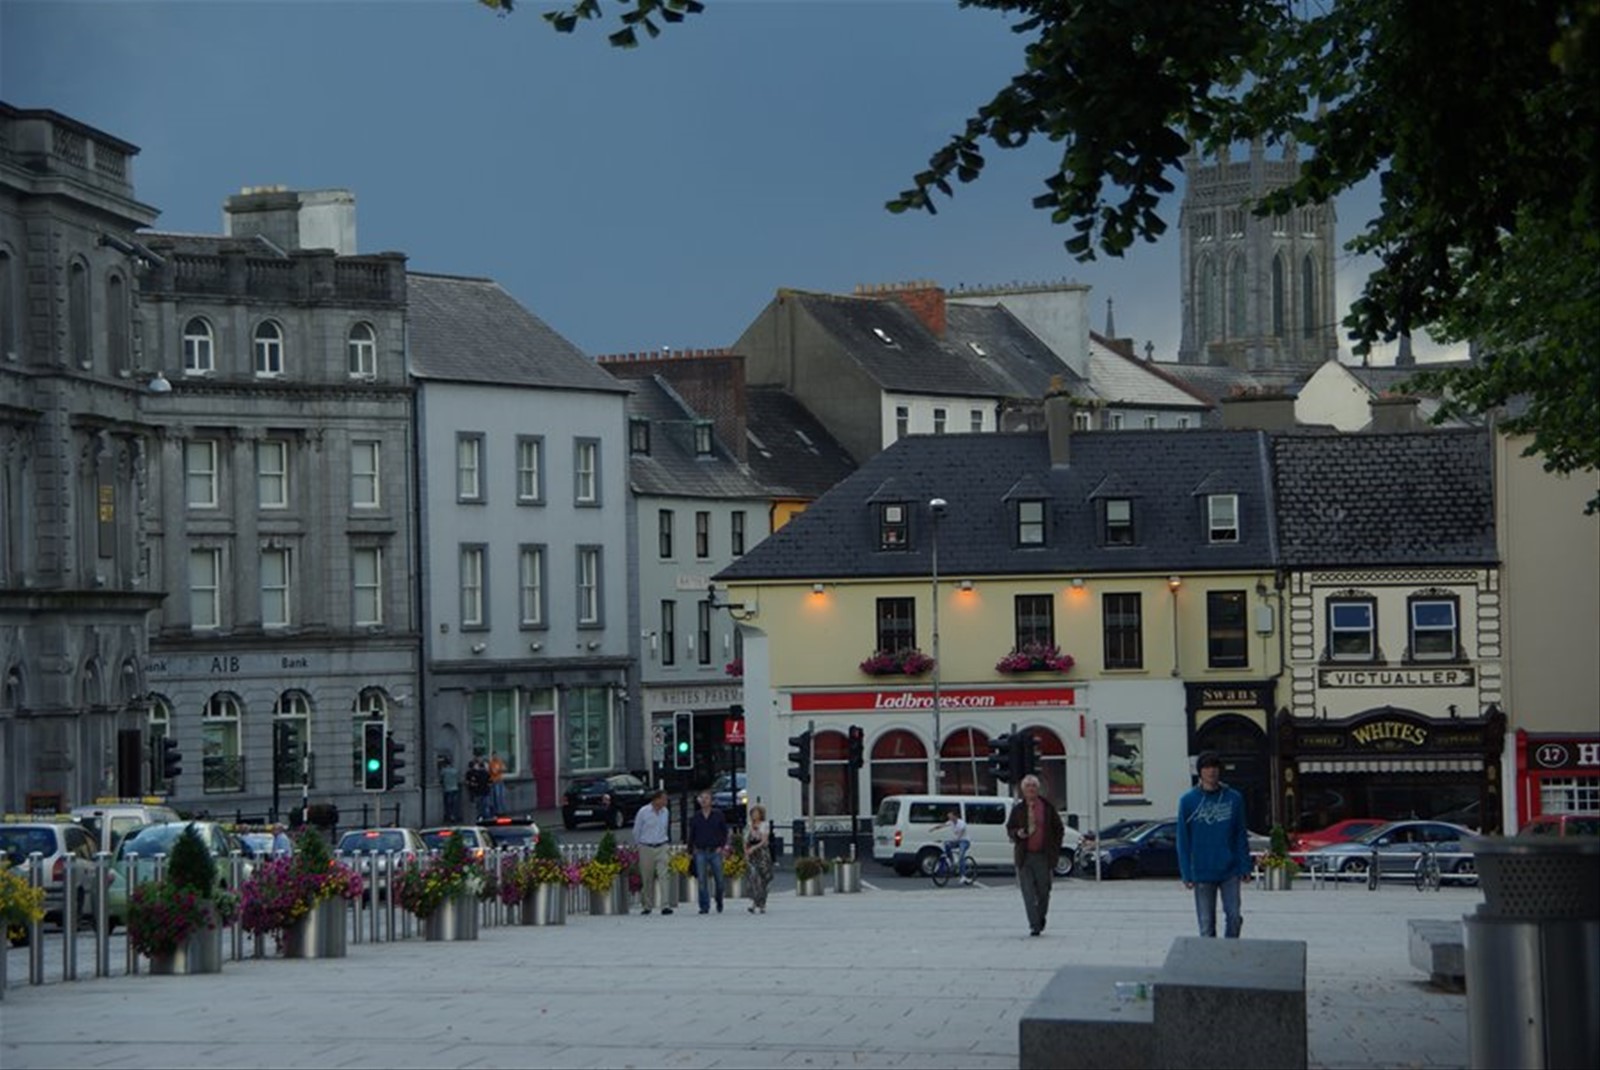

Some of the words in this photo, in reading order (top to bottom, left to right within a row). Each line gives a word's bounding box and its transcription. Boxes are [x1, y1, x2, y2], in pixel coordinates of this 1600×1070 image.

[144, 661, 166, 672] ank
[212, 656, 239, 671] AIB
[282, 657, 308, 668] Bank
[1336, 671, 1459, 685] VICTUALLER
[663, 691, 700, 704] WHITES
[1202, 688, 1258, 700] Swans
[1352, 721, 1428, 747] WHITES
[1543, 747, 1561, 762] 17
